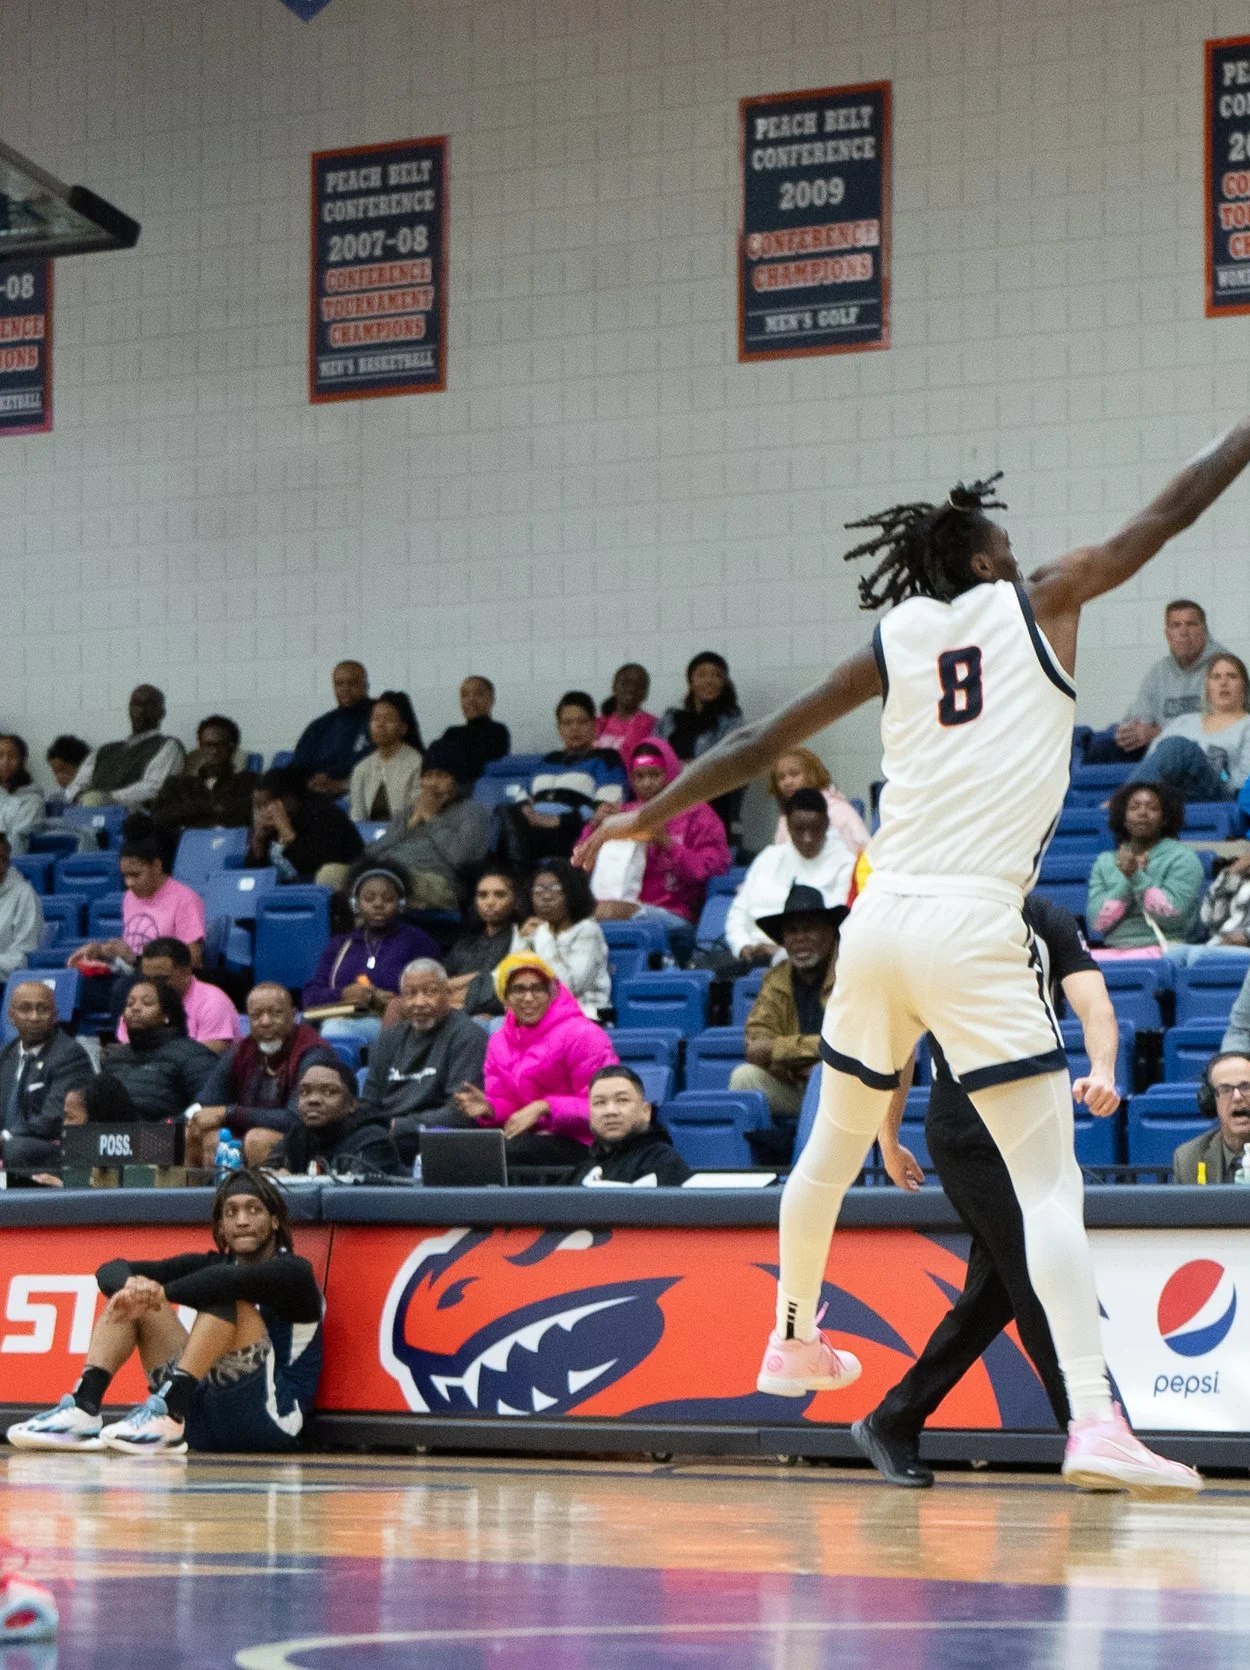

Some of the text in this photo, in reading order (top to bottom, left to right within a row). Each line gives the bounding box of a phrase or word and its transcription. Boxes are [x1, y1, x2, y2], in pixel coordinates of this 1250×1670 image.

[755, 105, 873, 141] PEACH BELT
[752, 136, 877, 170] CONFERENCE
[326, 160, 433, 193] PEACH BELT
[779, 176, 845, 211] 2009
[323, 189, 435, 223] CONFERENCE
[328, 224, 428, 262] 2007-08
[747, 219, 880, 260] CONFERENCE
[325, 258, 432, 294] CONFERENCE
[754, 252, 873, 293] CHAMPIONS
[321, 285, 434, 322] TOURNAMENT
[764, 306, 860, 333] MEN'S GOLF
[329, 315, 426, 348] CHAMPIONS
[938, 645, 983, 727] 8
[99, 1134, 133, 1156] POSS.
[1153, 1371, 1218, 1399] pepsi
